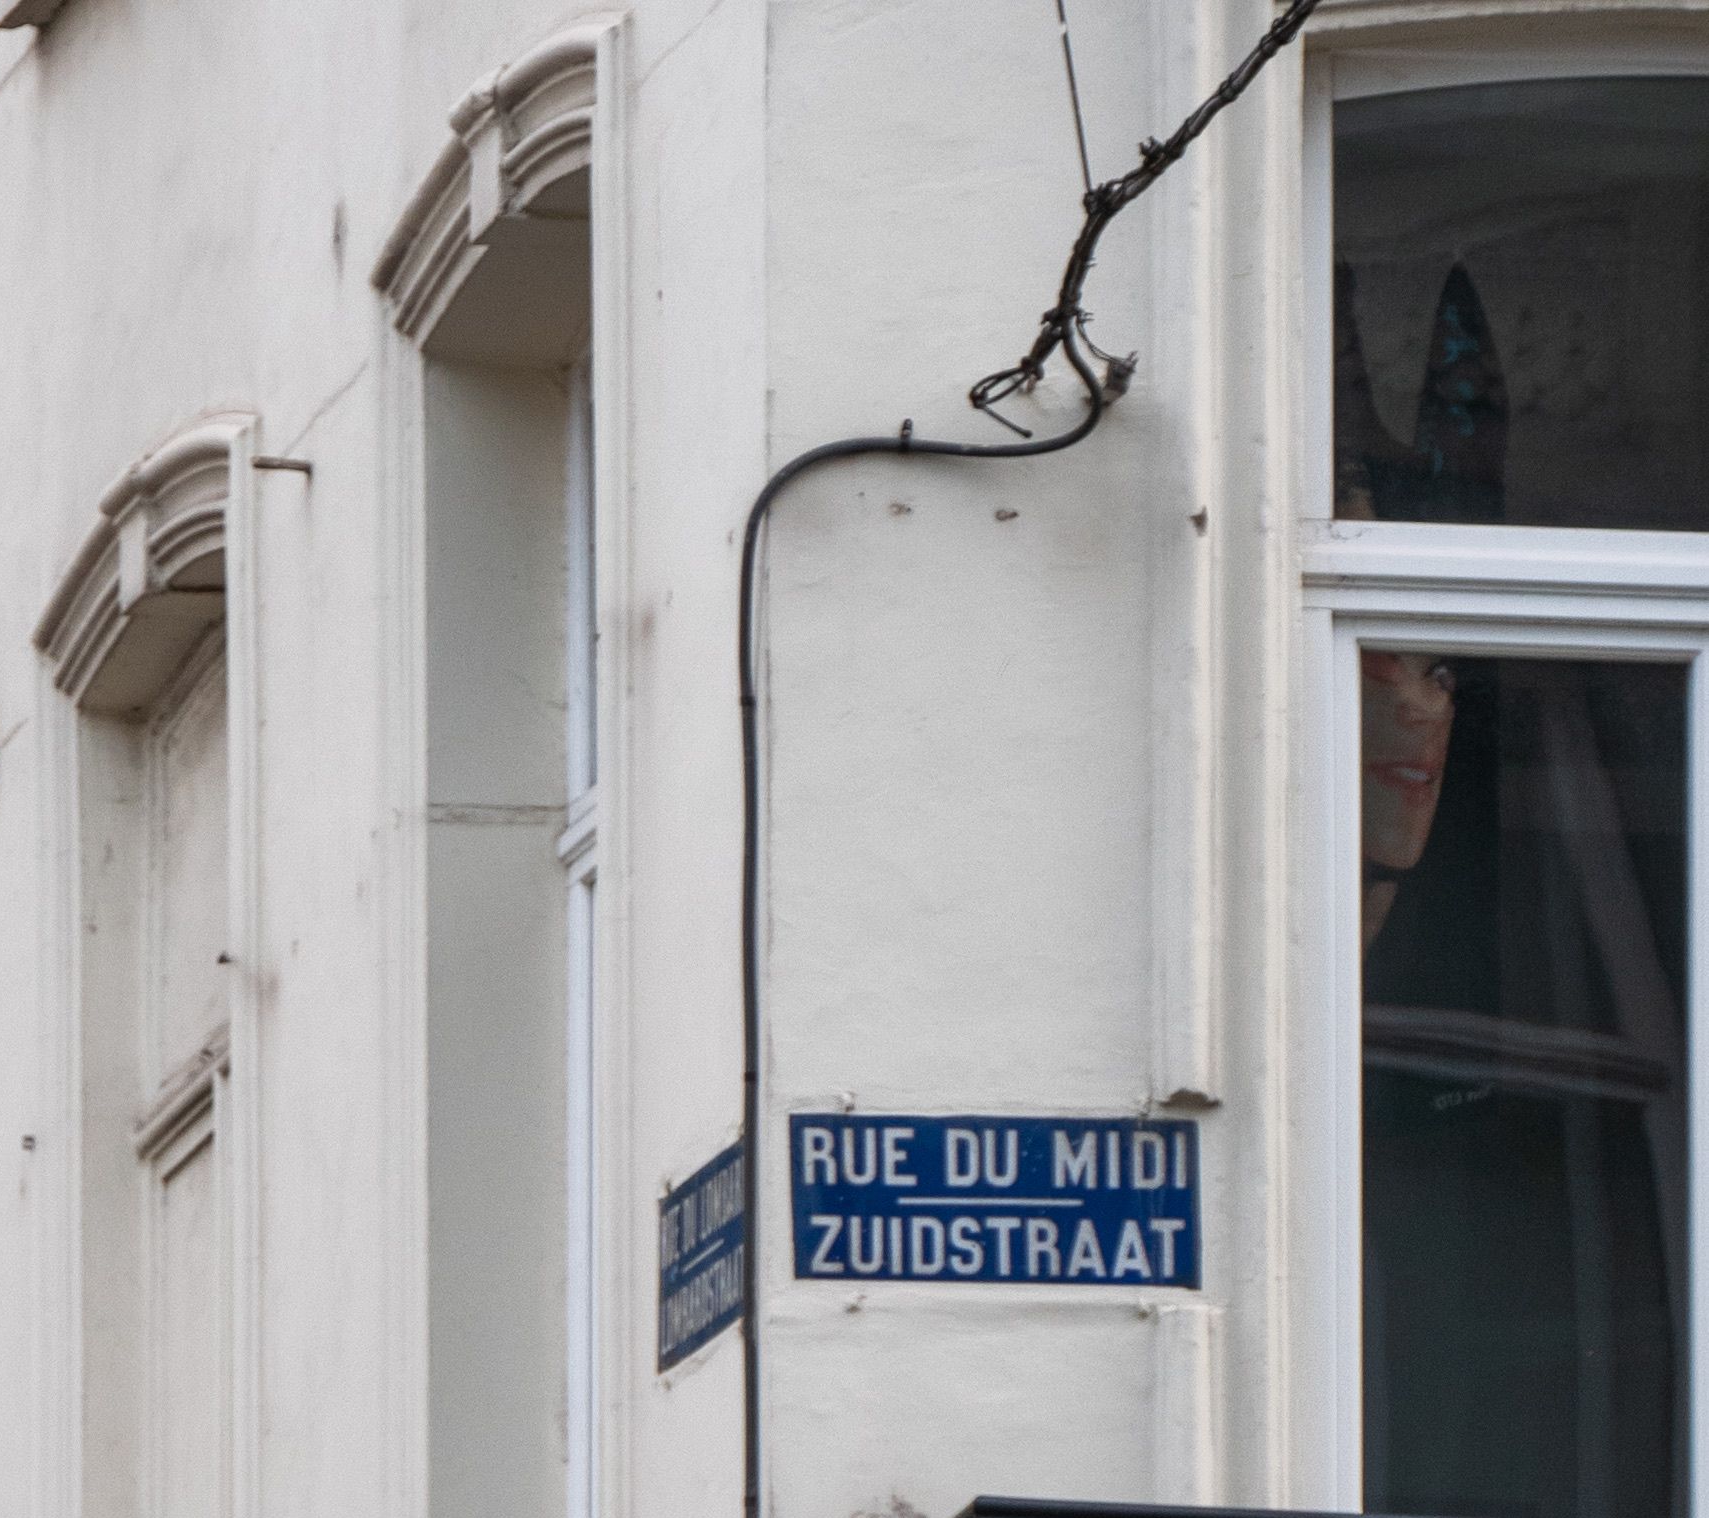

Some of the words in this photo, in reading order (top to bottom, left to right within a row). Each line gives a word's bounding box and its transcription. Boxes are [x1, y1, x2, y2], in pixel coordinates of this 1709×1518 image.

[803, 1127, 918, 1187] RUE
[945, 1128, 1019, 1188] DU
[1052, 1130, 1187, 1190] MIDI
[809, 1215, 1186, 1279] ZUIDSTRAAT
